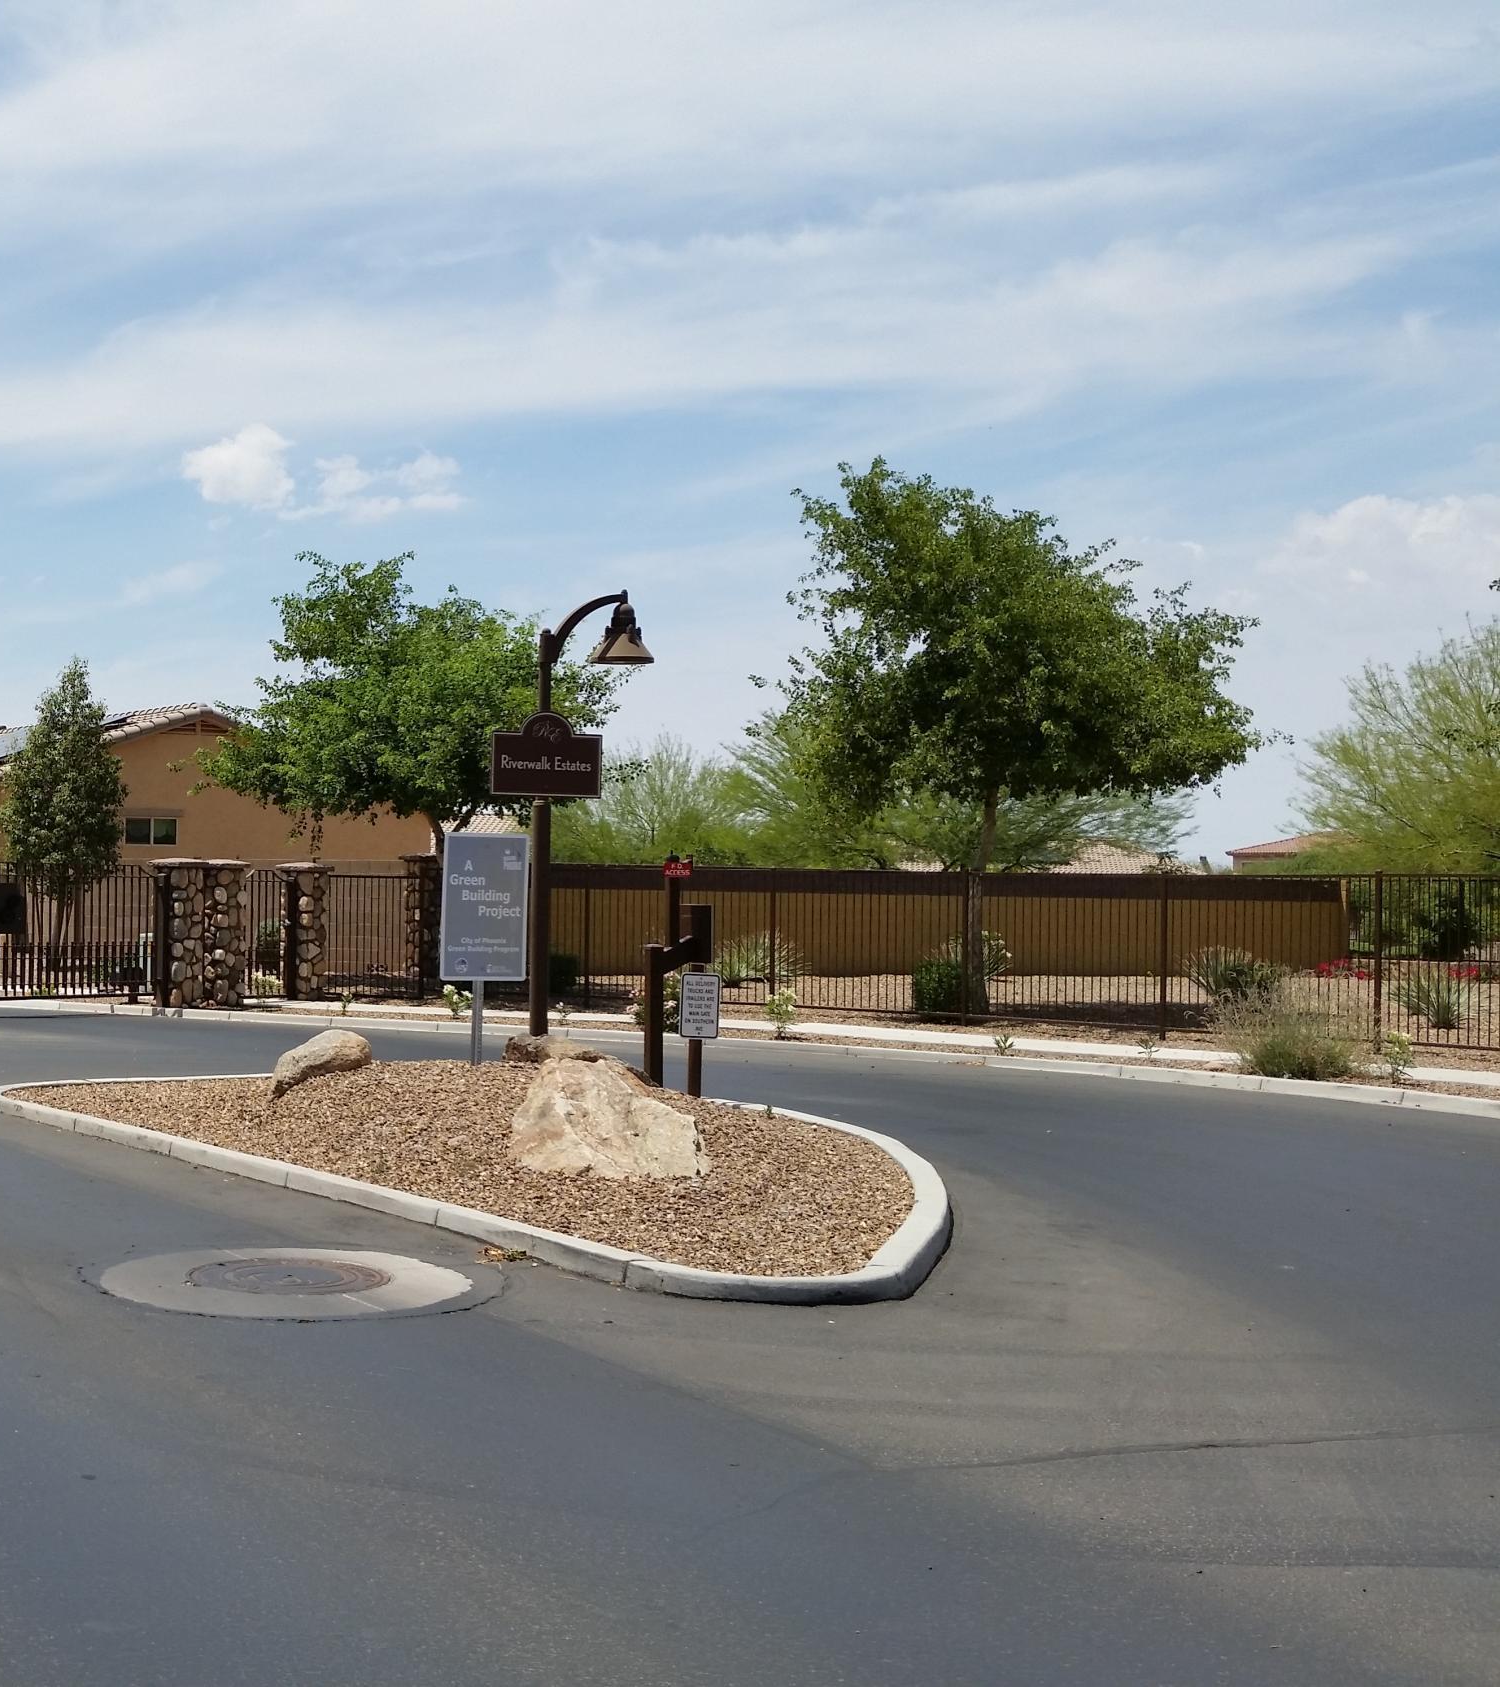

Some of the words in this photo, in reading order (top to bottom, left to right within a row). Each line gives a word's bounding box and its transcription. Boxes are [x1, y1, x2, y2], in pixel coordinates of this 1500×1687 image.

[501, 754, 551, 771] Riverwalk
[554, 756, 592, 772] Estates
[464, 859, 474, 871] A
[450, 873, 486, 886] Green
[461, 889, 511, 904] Building
[478, 905, 521, 919] Project
[461, 937, 473, 945] City
